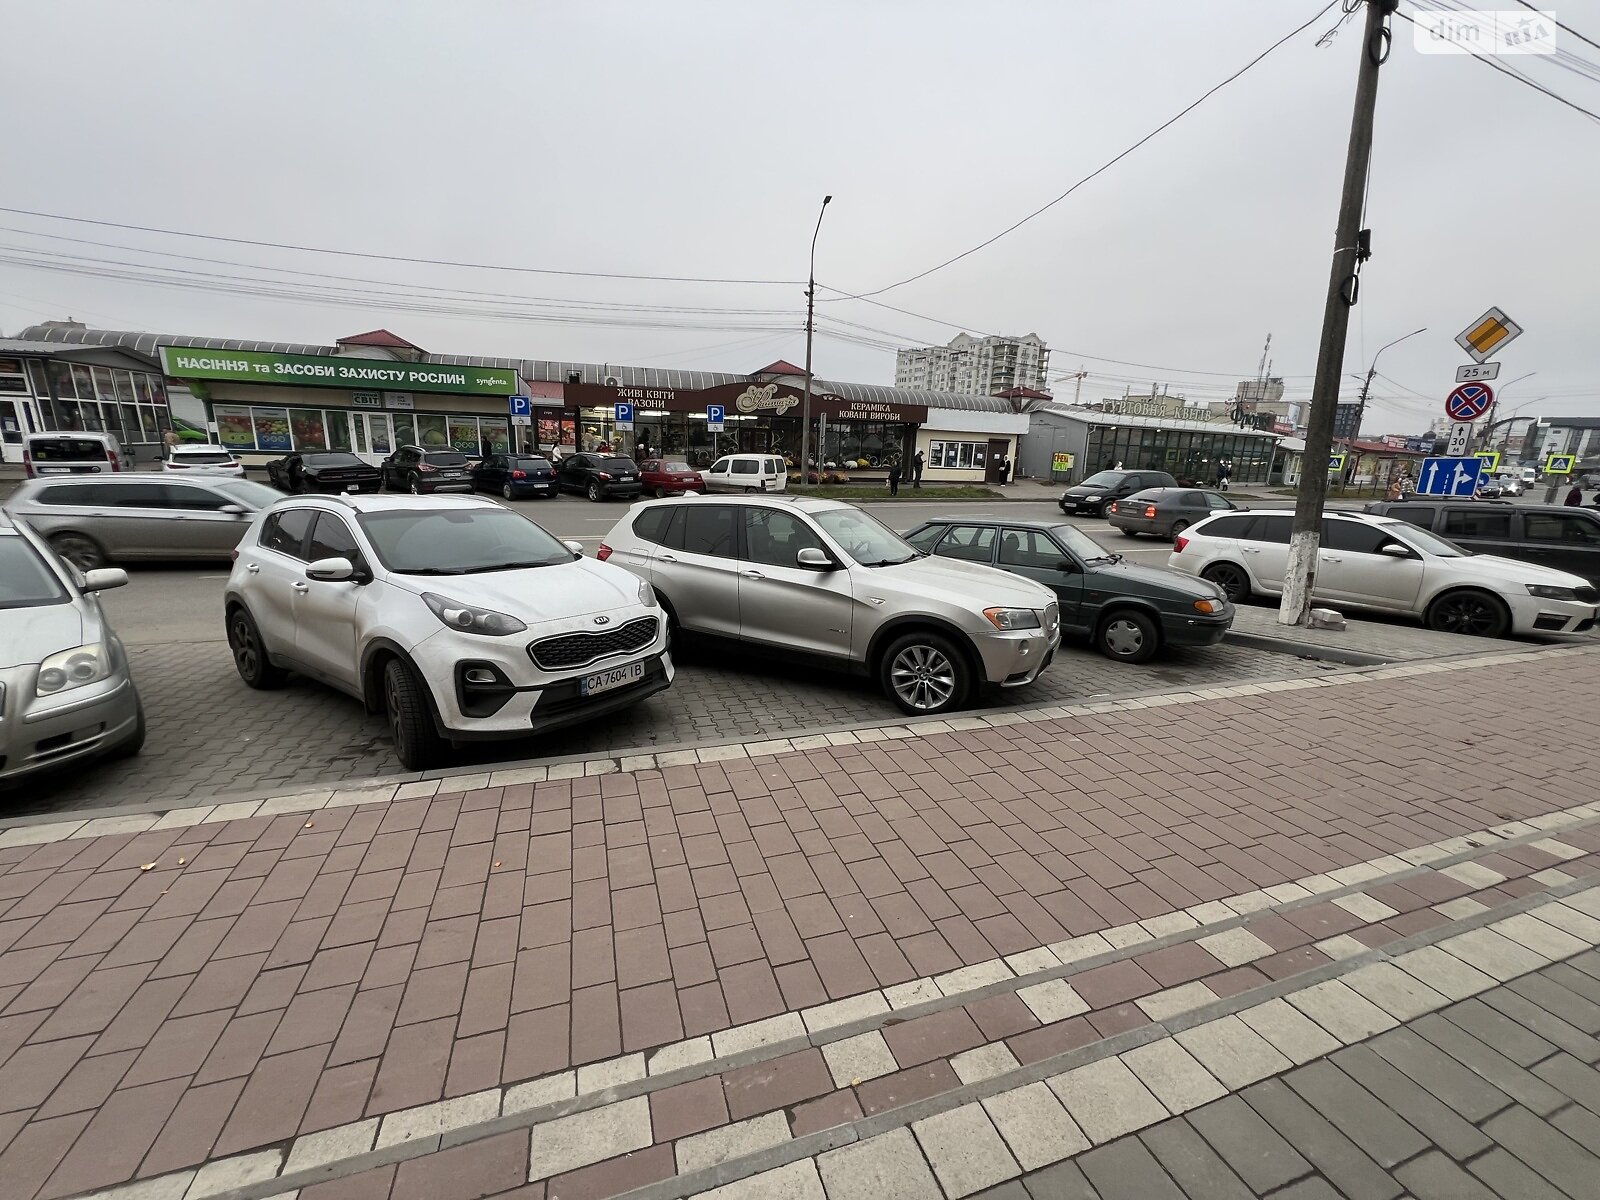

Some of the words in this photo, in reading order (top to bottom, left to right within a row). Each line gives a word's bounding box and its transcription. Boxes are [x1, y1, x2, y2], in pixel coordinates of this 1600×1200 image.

[176, 356, 249, 372] НАСІННЯ
[253, 364, 270, 373] та
[274, 362, 335, 377] ЗАСОБИ
[339, 367, 405, 382] ЗАХИСТУ
[409, 371, 466, 385] РОСЛИН
[1463, 368, 1479, 378] 25
[354, 396, 379, 405] СВІТ
[617, 388, 644, 398] ЖИВІ
[646, 390, 675, 400] КВІТИ
[514, 398, 526, 412] P
[851, 402, 891, 412] КЕРАМІКА
[1101, 400, 1167, 416] ГУРТОВНЯ
[1174, 406, 1212, 421] КВІТІВ
[618, 405, 629, 419] P
[711, 407, 720, 421] P
[838, 410, 867, 419] КОВАНІ
[870, 411, 901, 421] ВИРОБИ
[1451, 437, 1465, 446] 30
[587, 676, 603, 690] CA
[604, 668, 627, 685] 7604
[630, 664, 642, 678] IB
